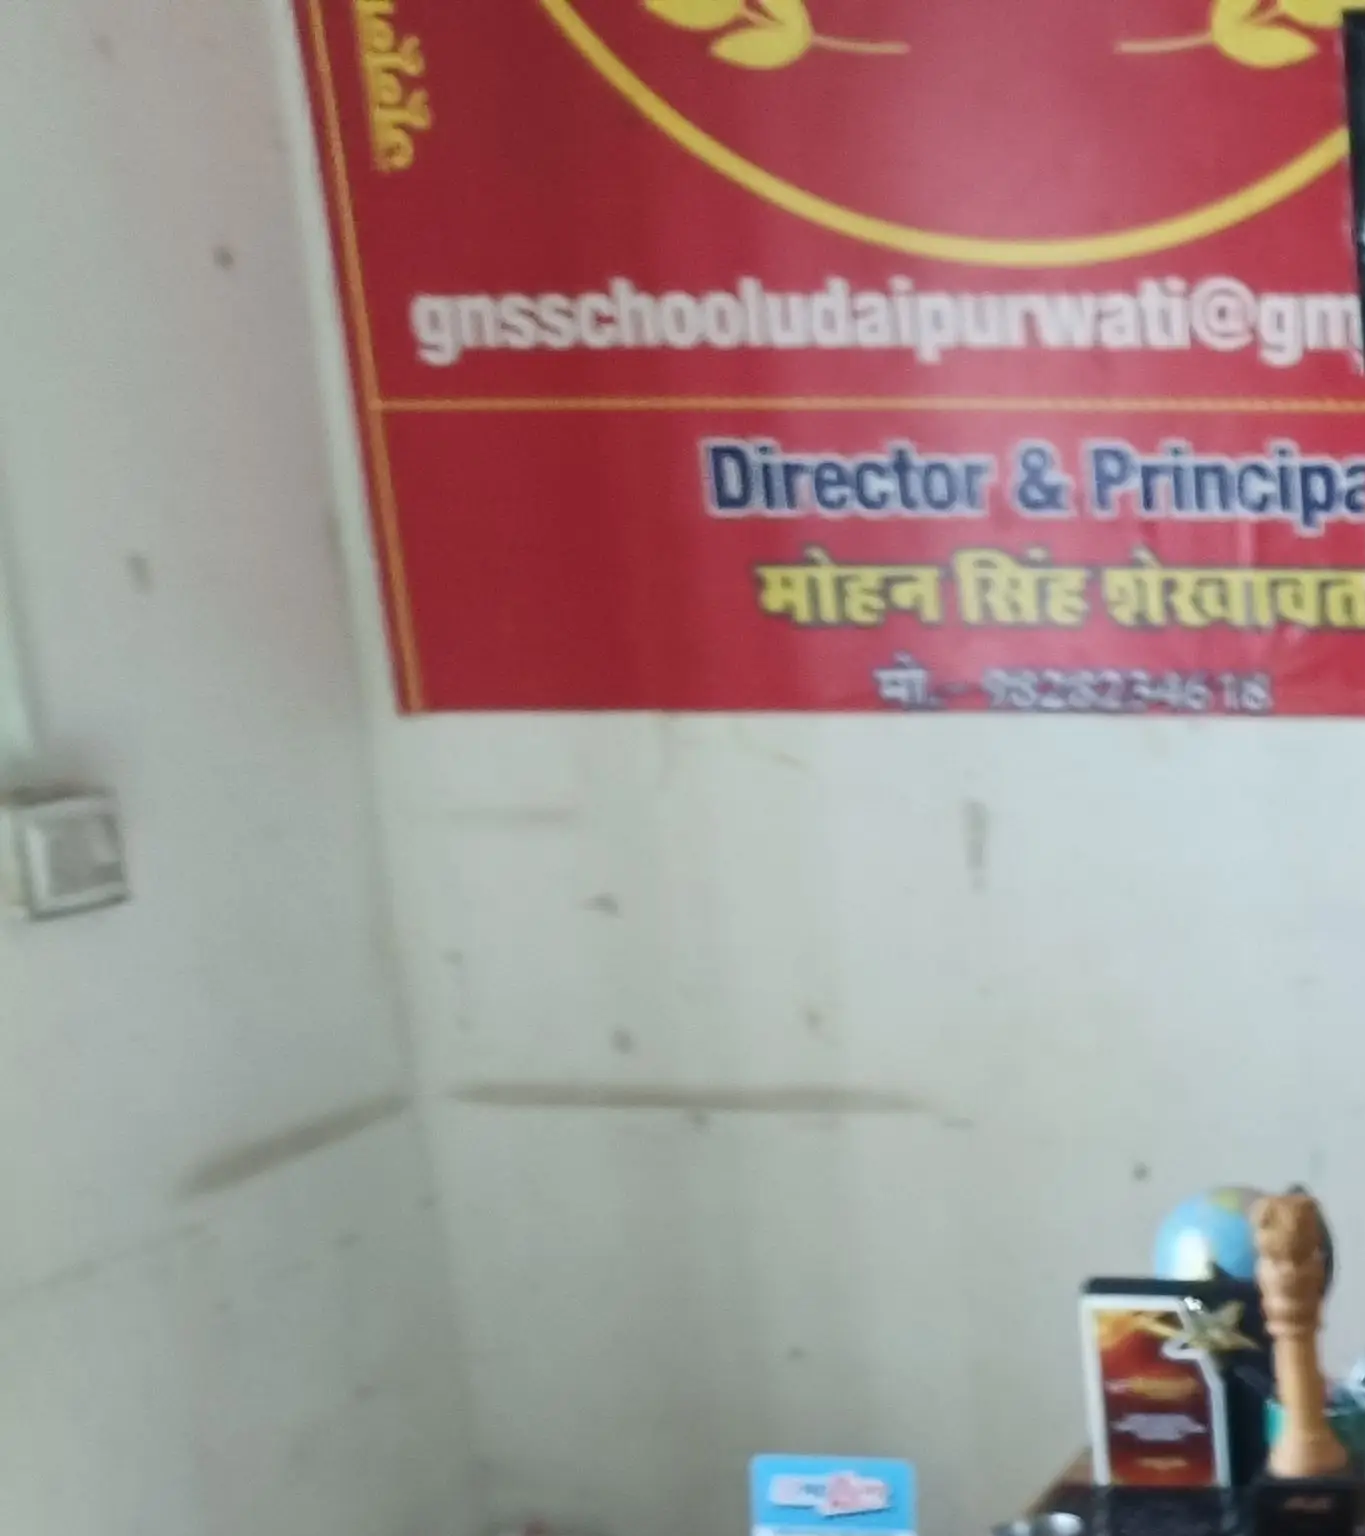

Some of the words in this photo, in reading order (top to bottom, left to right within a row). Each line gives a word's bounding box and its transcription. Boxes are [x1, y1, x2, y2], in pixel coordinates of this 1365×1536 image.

[702, 440, 993, 518] Director
[1011, 443, 1074, 517] &
[754, 546, 944, 627] मोहन
[952, 547, 1090, 627] सिंह
